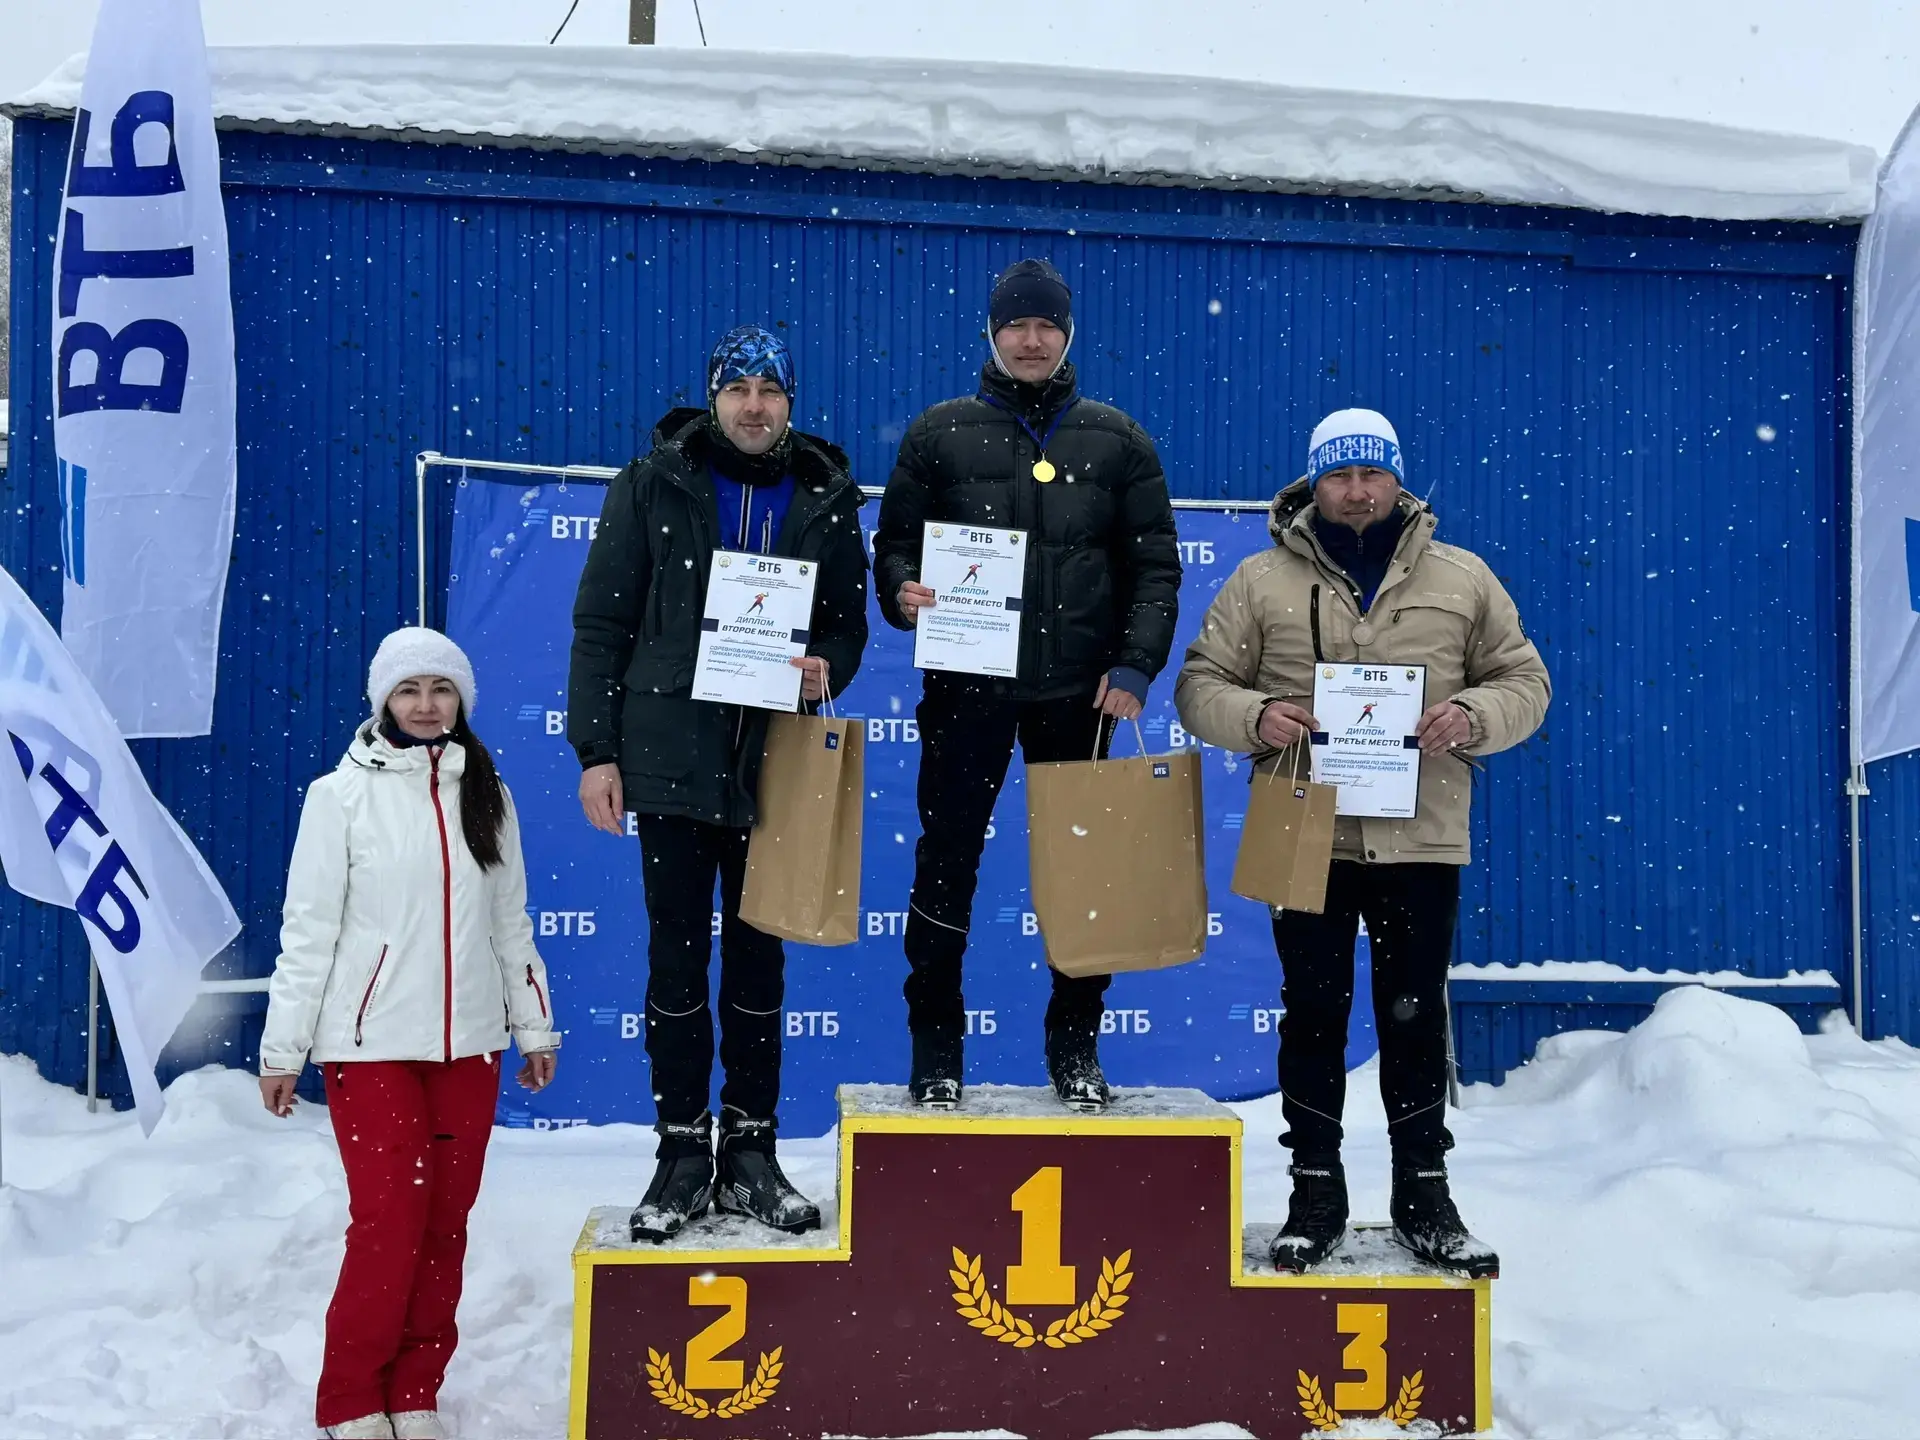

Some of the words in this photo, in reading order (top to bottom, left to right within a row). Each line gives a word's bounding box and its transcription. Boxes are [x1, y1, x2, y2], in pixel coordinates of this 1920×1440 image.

[57, 90, 195, 418] ВТБ
[1319, 436, 1384, 456] ЛЫЖНЯ
[1319, 448, 1384, 468] РОССИИ
[971, 532, 993, 544] ВТБ
[758, 561, 782, 574] ВТБ
[951, 586, 989, 596] ДИПЛОМ
[939, 595, 972, 605] ПЕРВОЕ
[973, 598, 1003, 608] МЕСТО
[735, 616, 775, 627] ДИПЛОМ
[722, 625, 757, 636] ВТОРОЕ
[757, 628, 789, 639] МЕСТО
[1364, 670, 1388, 682] ВТБ
[868, 718, 920, 742] ВТБ
[1345, 727, 1385, 736] ДИПЛОМ
[1333, 737, 1367, 746] ТРЕТЬЕ
[1368, 738, 1400, 747] МЕСТО
[539, 912, 596, 936] ВТБ
[866, 912, 908, 936] ВТ
[786, 1012, 840, 1037] ВТБ
[964, 1010, 997, 1035] ТБ
[1099, 1010, 1151, 1034] ВТБ
[667, 1125, 705, 1134] SPINE
[736, 1120, 771, 1128] SPINE
[1006, 1167, 1076, 1305] 1
[685, 1277, 747, 1389] 2
[1334, 1303, 1388, 1411] 3
